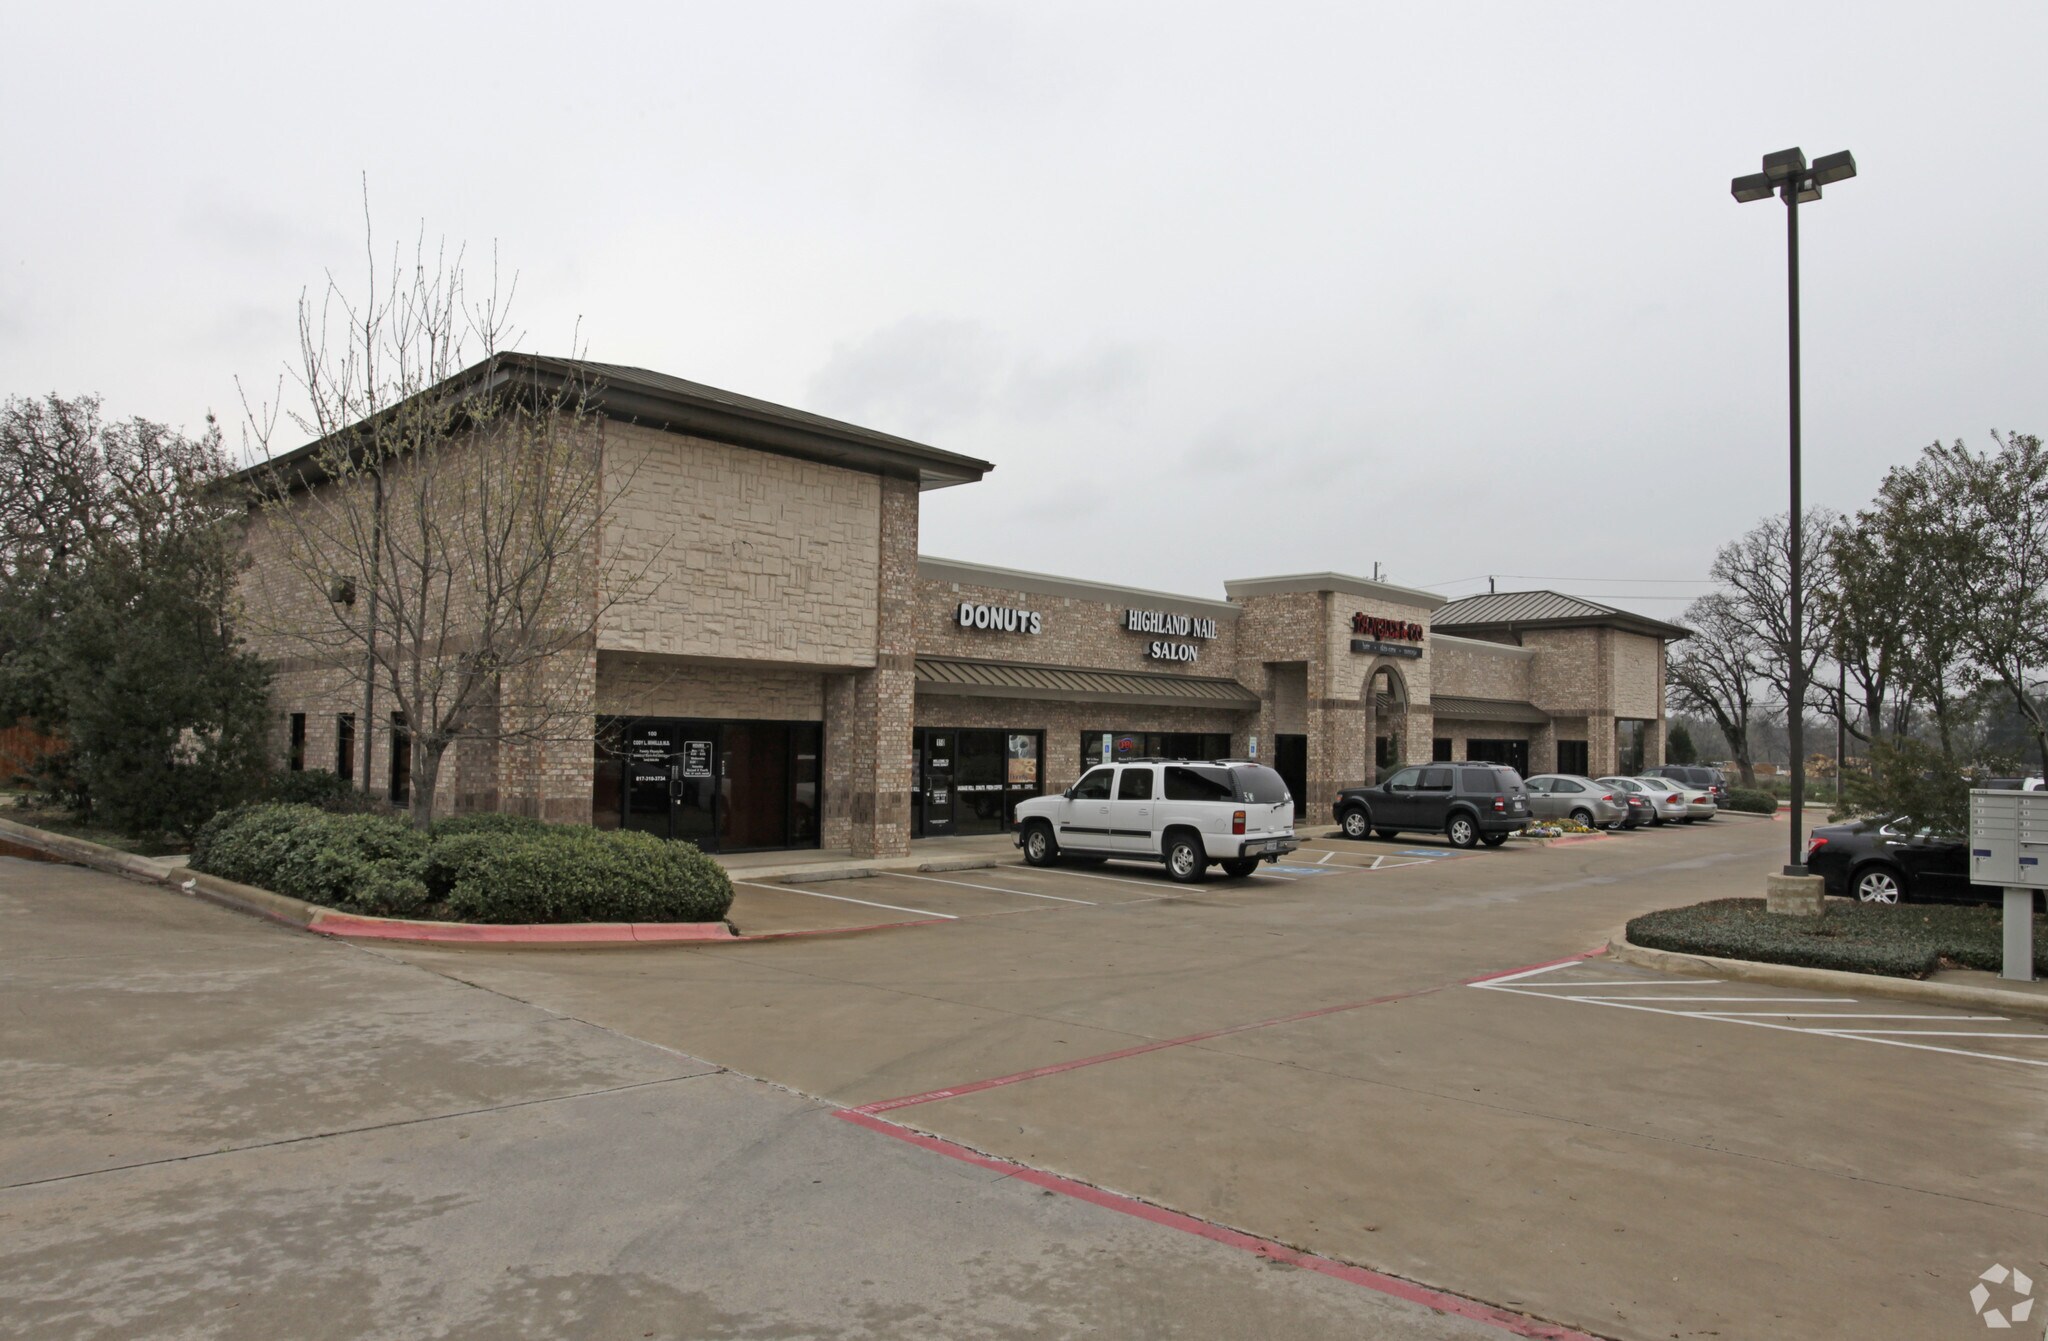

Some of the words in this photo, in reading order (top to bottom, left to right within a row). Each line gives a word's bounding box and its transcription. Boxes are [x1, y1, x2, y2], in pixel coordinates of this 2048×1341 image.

[959, 603, 1041, 635] DONUTS
[1128, 609, 1190, 637] HIGHLAND
[1193, 617, 1218, 639] NAIL
[1151, 641, 1198, 661] SALON
